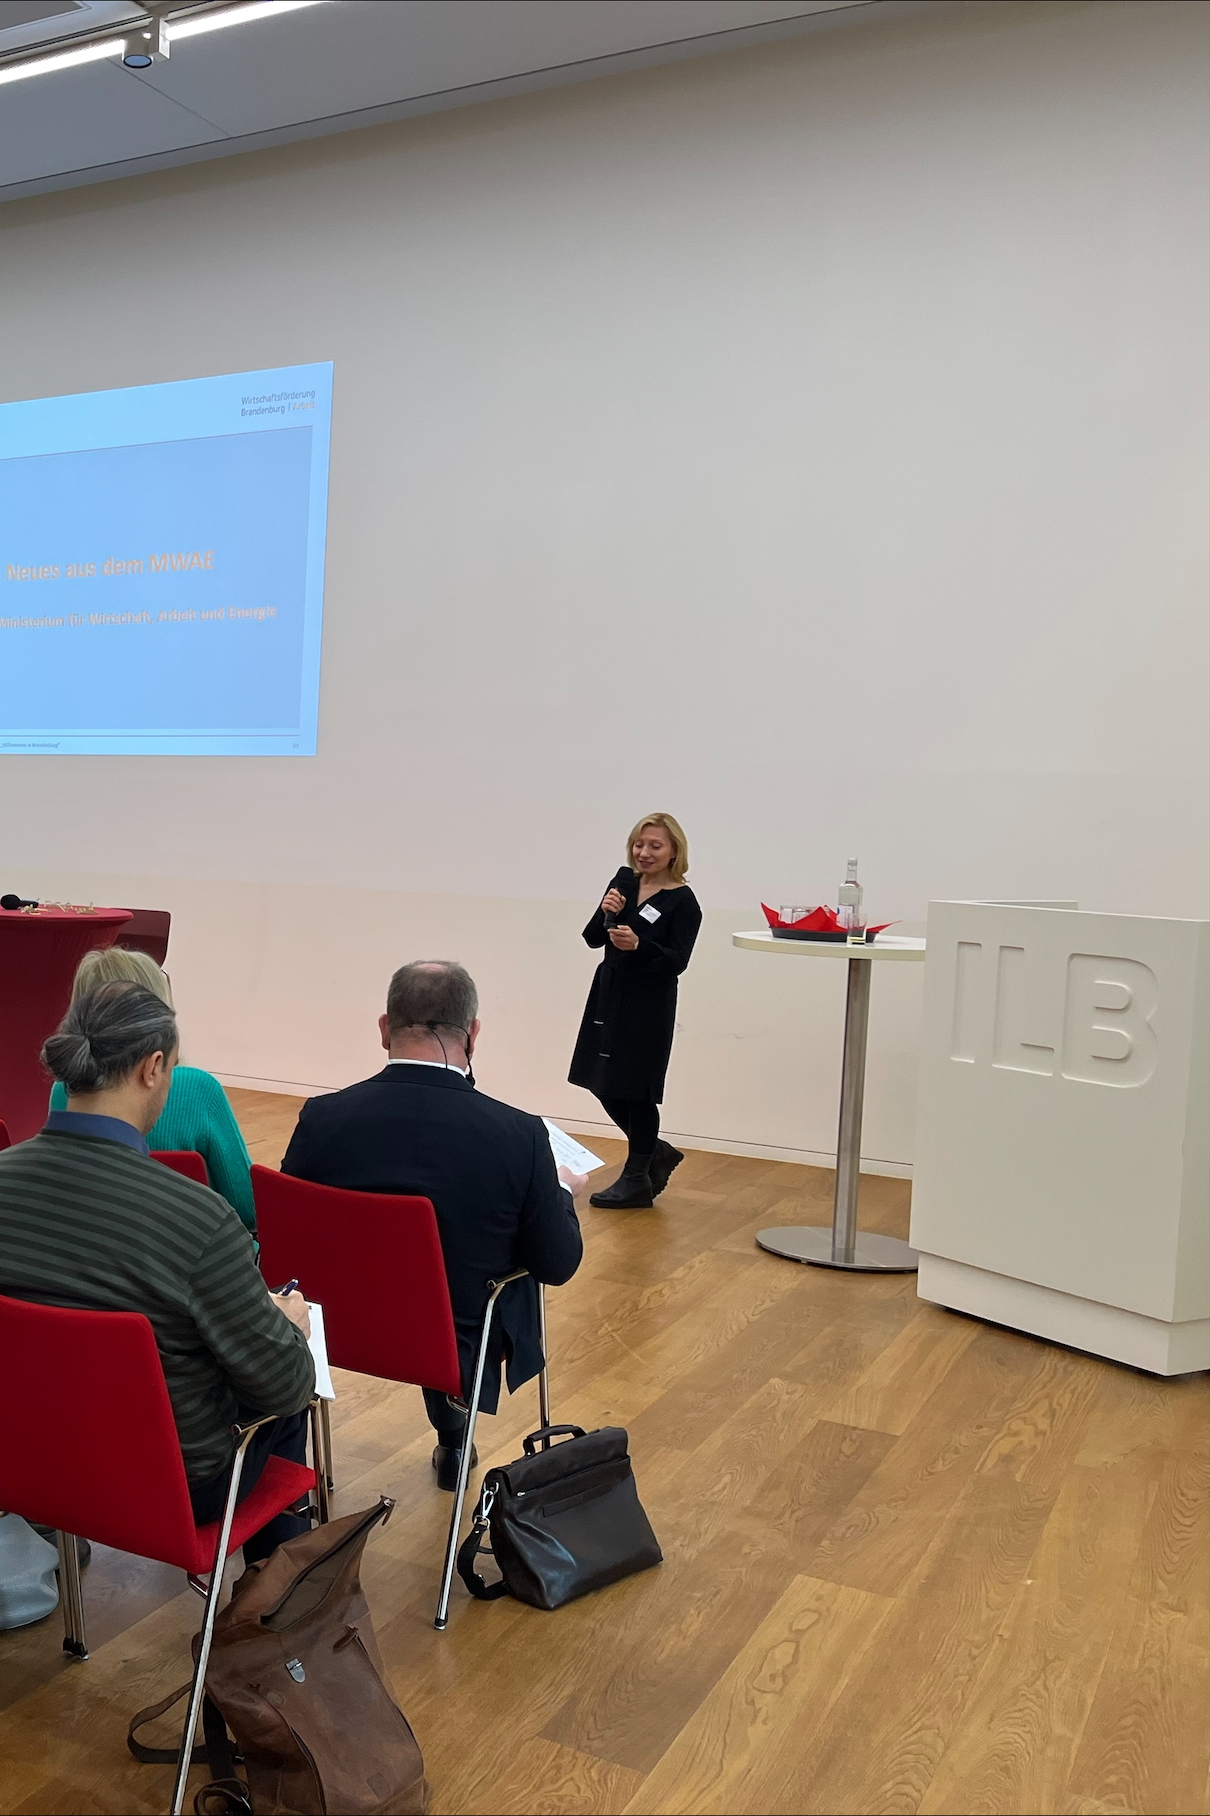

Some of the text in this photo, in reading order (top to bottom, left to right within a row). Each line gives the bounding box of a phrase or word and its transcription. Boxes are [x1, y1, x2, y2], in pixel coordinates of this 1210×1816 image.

[241, 390, 316, 405] Wirtschaftsförderung
[241, 400, 315, 417] Brandenburg Arbeit
[6, 563, 60, 581] Neues
[65, 561, 96, 579] aus
[101, 556, 143, 576] dem
[148, 550, 215, 573] MWAE
[68, 612, 85, 626] für
[88, 610, 154, 625] Wirtschaft,
[157, 607, 196, 622] Arbeit
[199, 606, 224, 620] und
[228, 604, 277, 622] Energie
[951, 940, 1159, 1089] ILB
